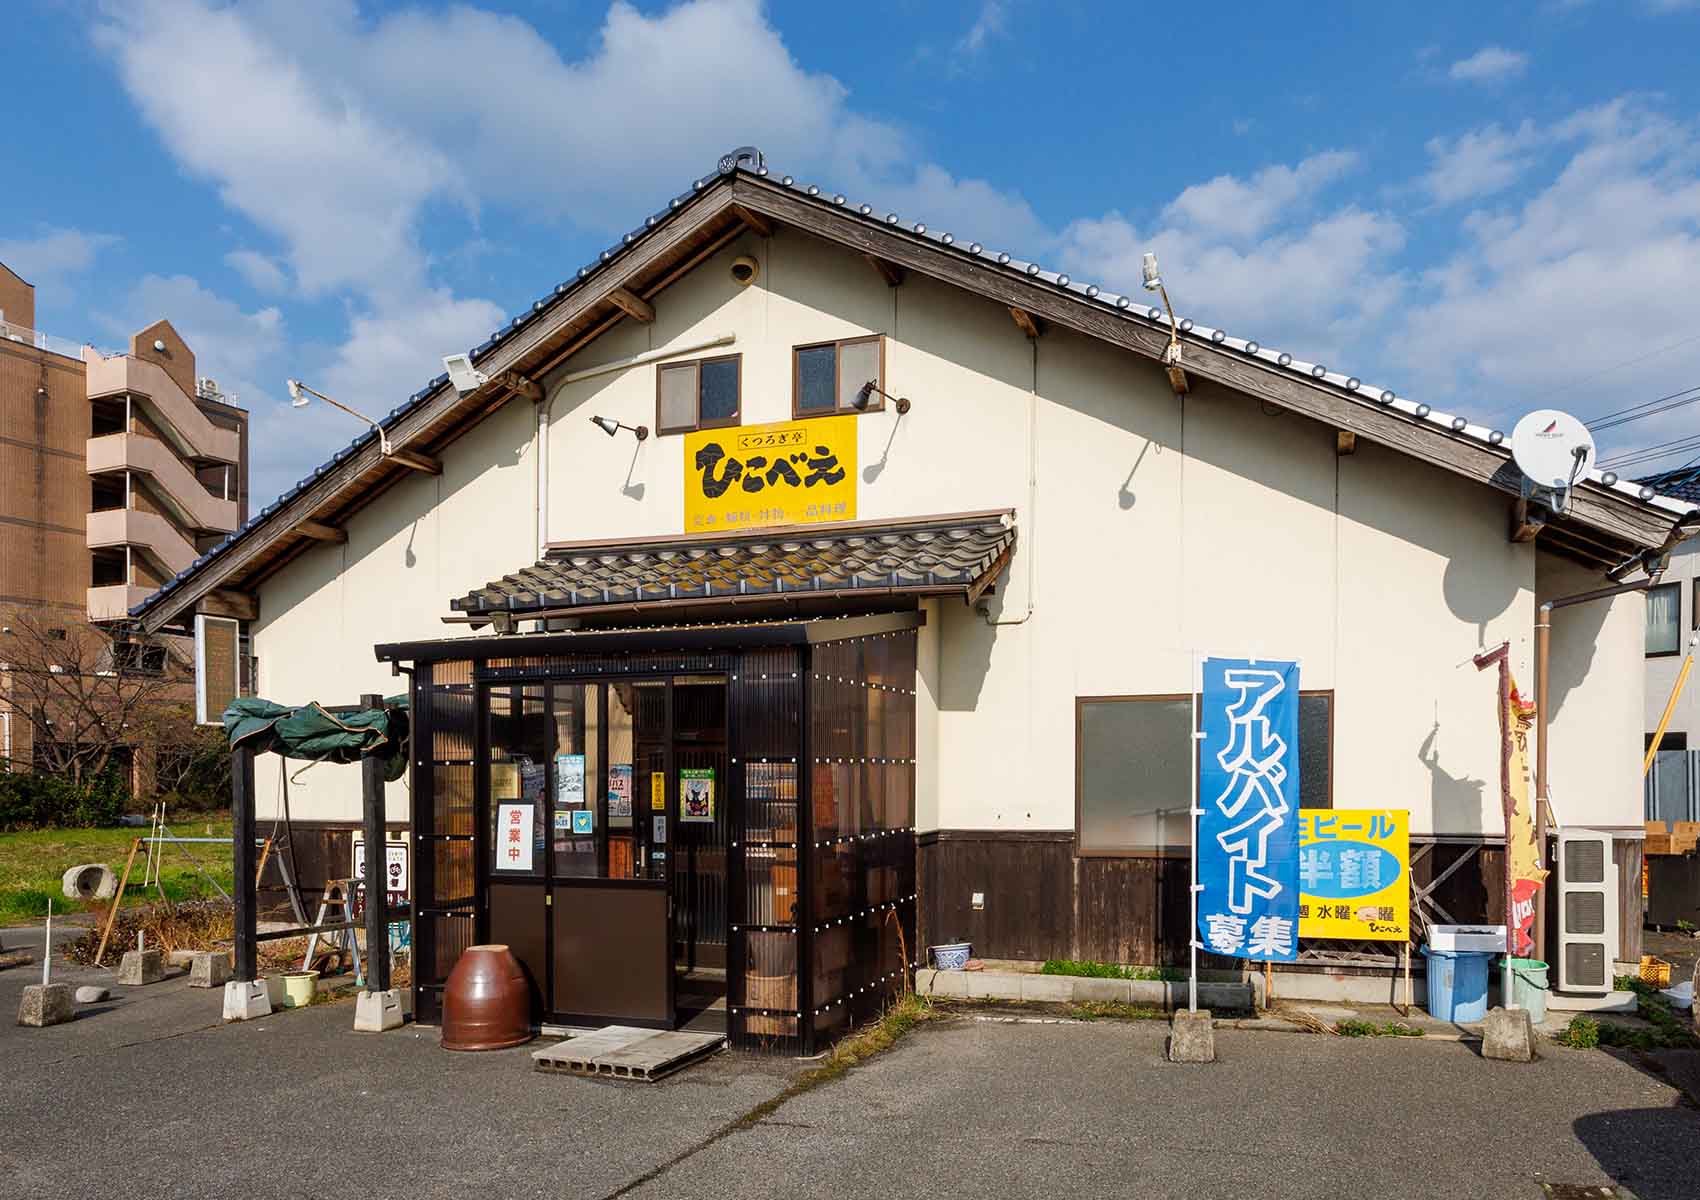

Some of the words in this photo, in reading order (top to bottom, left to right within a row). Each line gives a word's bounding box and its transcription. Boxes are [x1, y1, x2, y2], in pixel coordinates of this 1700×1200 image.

[742, 432, 802, 447] くつろぎ亭
[696, 443, 845, 499] ひこべえ
[1216, 669, 1290, 914] アルバイト
[508, 809, 521, 861] 営業中
[1299, 849, 1382, 889] 半額
[1206, 913, 1293, 956] 募集
[1317, 905, 1394, 922] 水曜・曜
